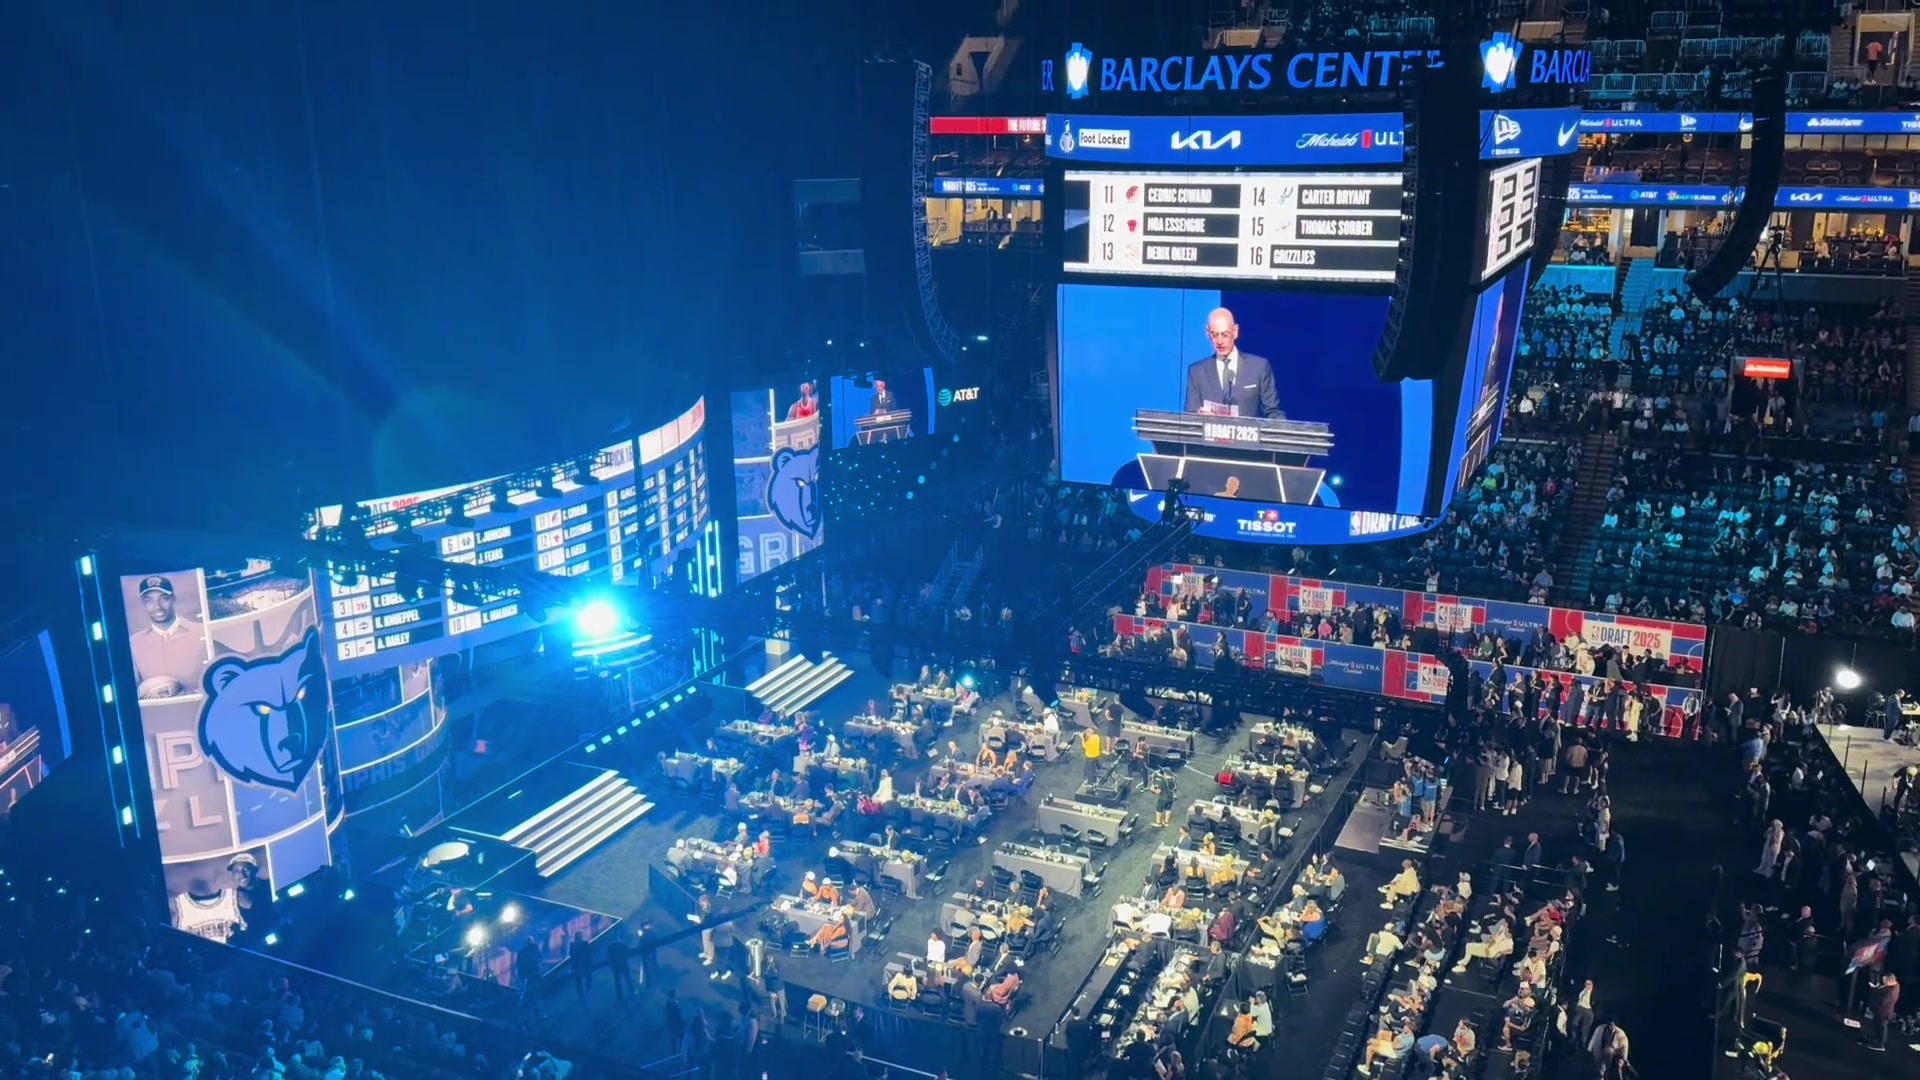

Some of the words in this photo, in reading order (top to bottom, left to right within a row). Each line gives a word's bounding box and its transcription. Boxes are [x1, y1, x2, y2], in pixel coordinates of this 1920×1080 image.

[1100, 54, 1273, 91] BARCLAYS
[1611, 119, 1642, 127] ULTRA
[1081, 133, 1096, 144] Foot
[1097, 133, 1127, 145] Locker
[1296, 132, 1359, 149] Michelob
[1105, 185, 1114, 203] 11
[1253, 187, 1265, 206] 14
[1302, 189, 1335, 204] CARTER
[1336, 190, 1371, 205] BRYANT
[1103, 214, 1114, 232] 12
[1252, 217, 1264, 236] 15
[1301, 220, 1336, 234] THOMAS
[1103, 242, 1114, 260] 13
[1250, 247, 1263, 265] 16
[1273, 249, 1316, 265] GRIZZLIES
[953, 387, 980, 402] AT&T
[1212, 423, 1236, 440] DRAFT
[1236, 426, 1259, 442] 2025
[1237, 519, 1296, 533] TISSOT
[447, 538, 453, 553] 6
[1312, 591, 1329, 601] DRAFT
[340, 602, 346, 615] 3
[342, 623, 348, 636] 4
[453, 618, 462, 632] 10
[1601, 626, 1633, 645] DRAFT
[1633, 630, 1662, 649] 2025
[344, 644, 351, 657] 5
[377, 637, 386, 650] A.
[1289, 648, 1307, 658] DRAFT
[1355, 662, 1380, 672] ULTRA
